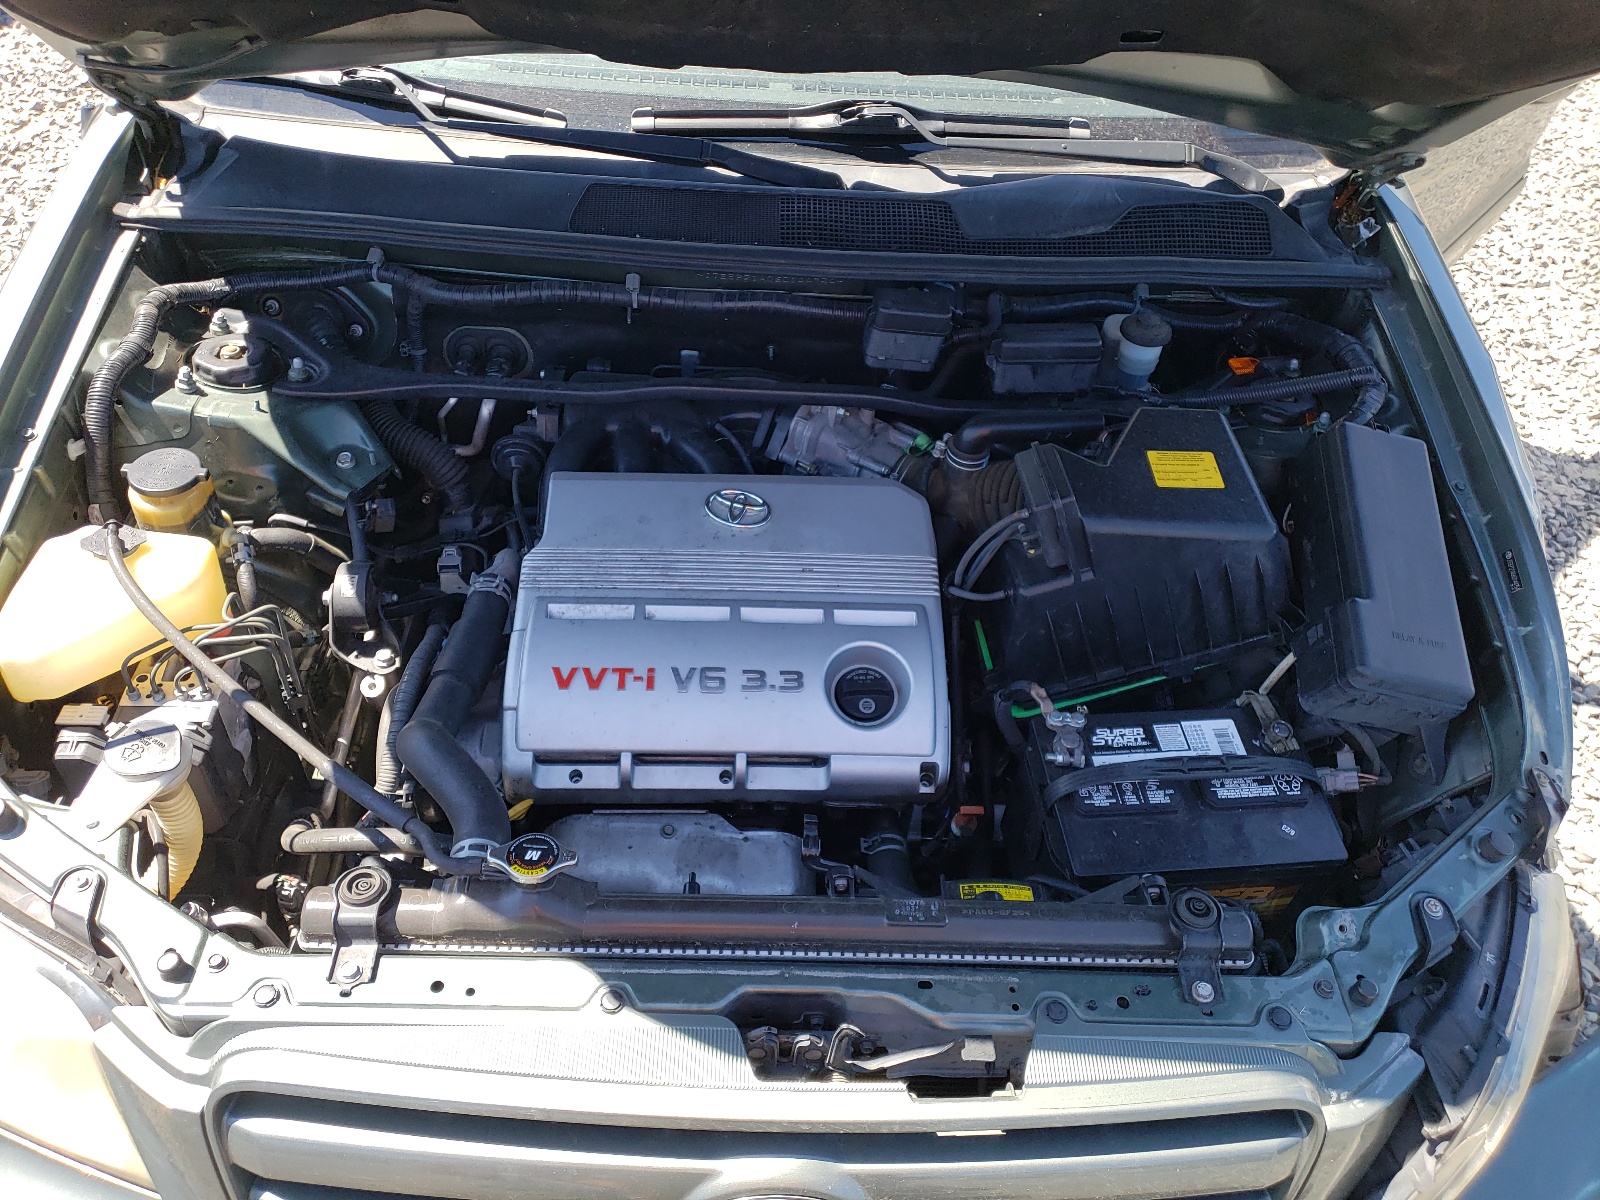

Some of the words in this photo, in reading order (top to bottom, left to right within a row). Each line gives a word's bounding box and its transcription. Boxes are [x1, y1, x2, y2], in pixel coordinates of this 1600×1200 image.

[551, 667, 656, 691] VVT-i
[670, 667, 727, 694] V6
[740, 669, 805, 694] 3.3
[1095, 727, 1144, 738] SUPER
[1092, 735, 1146, 746] START
